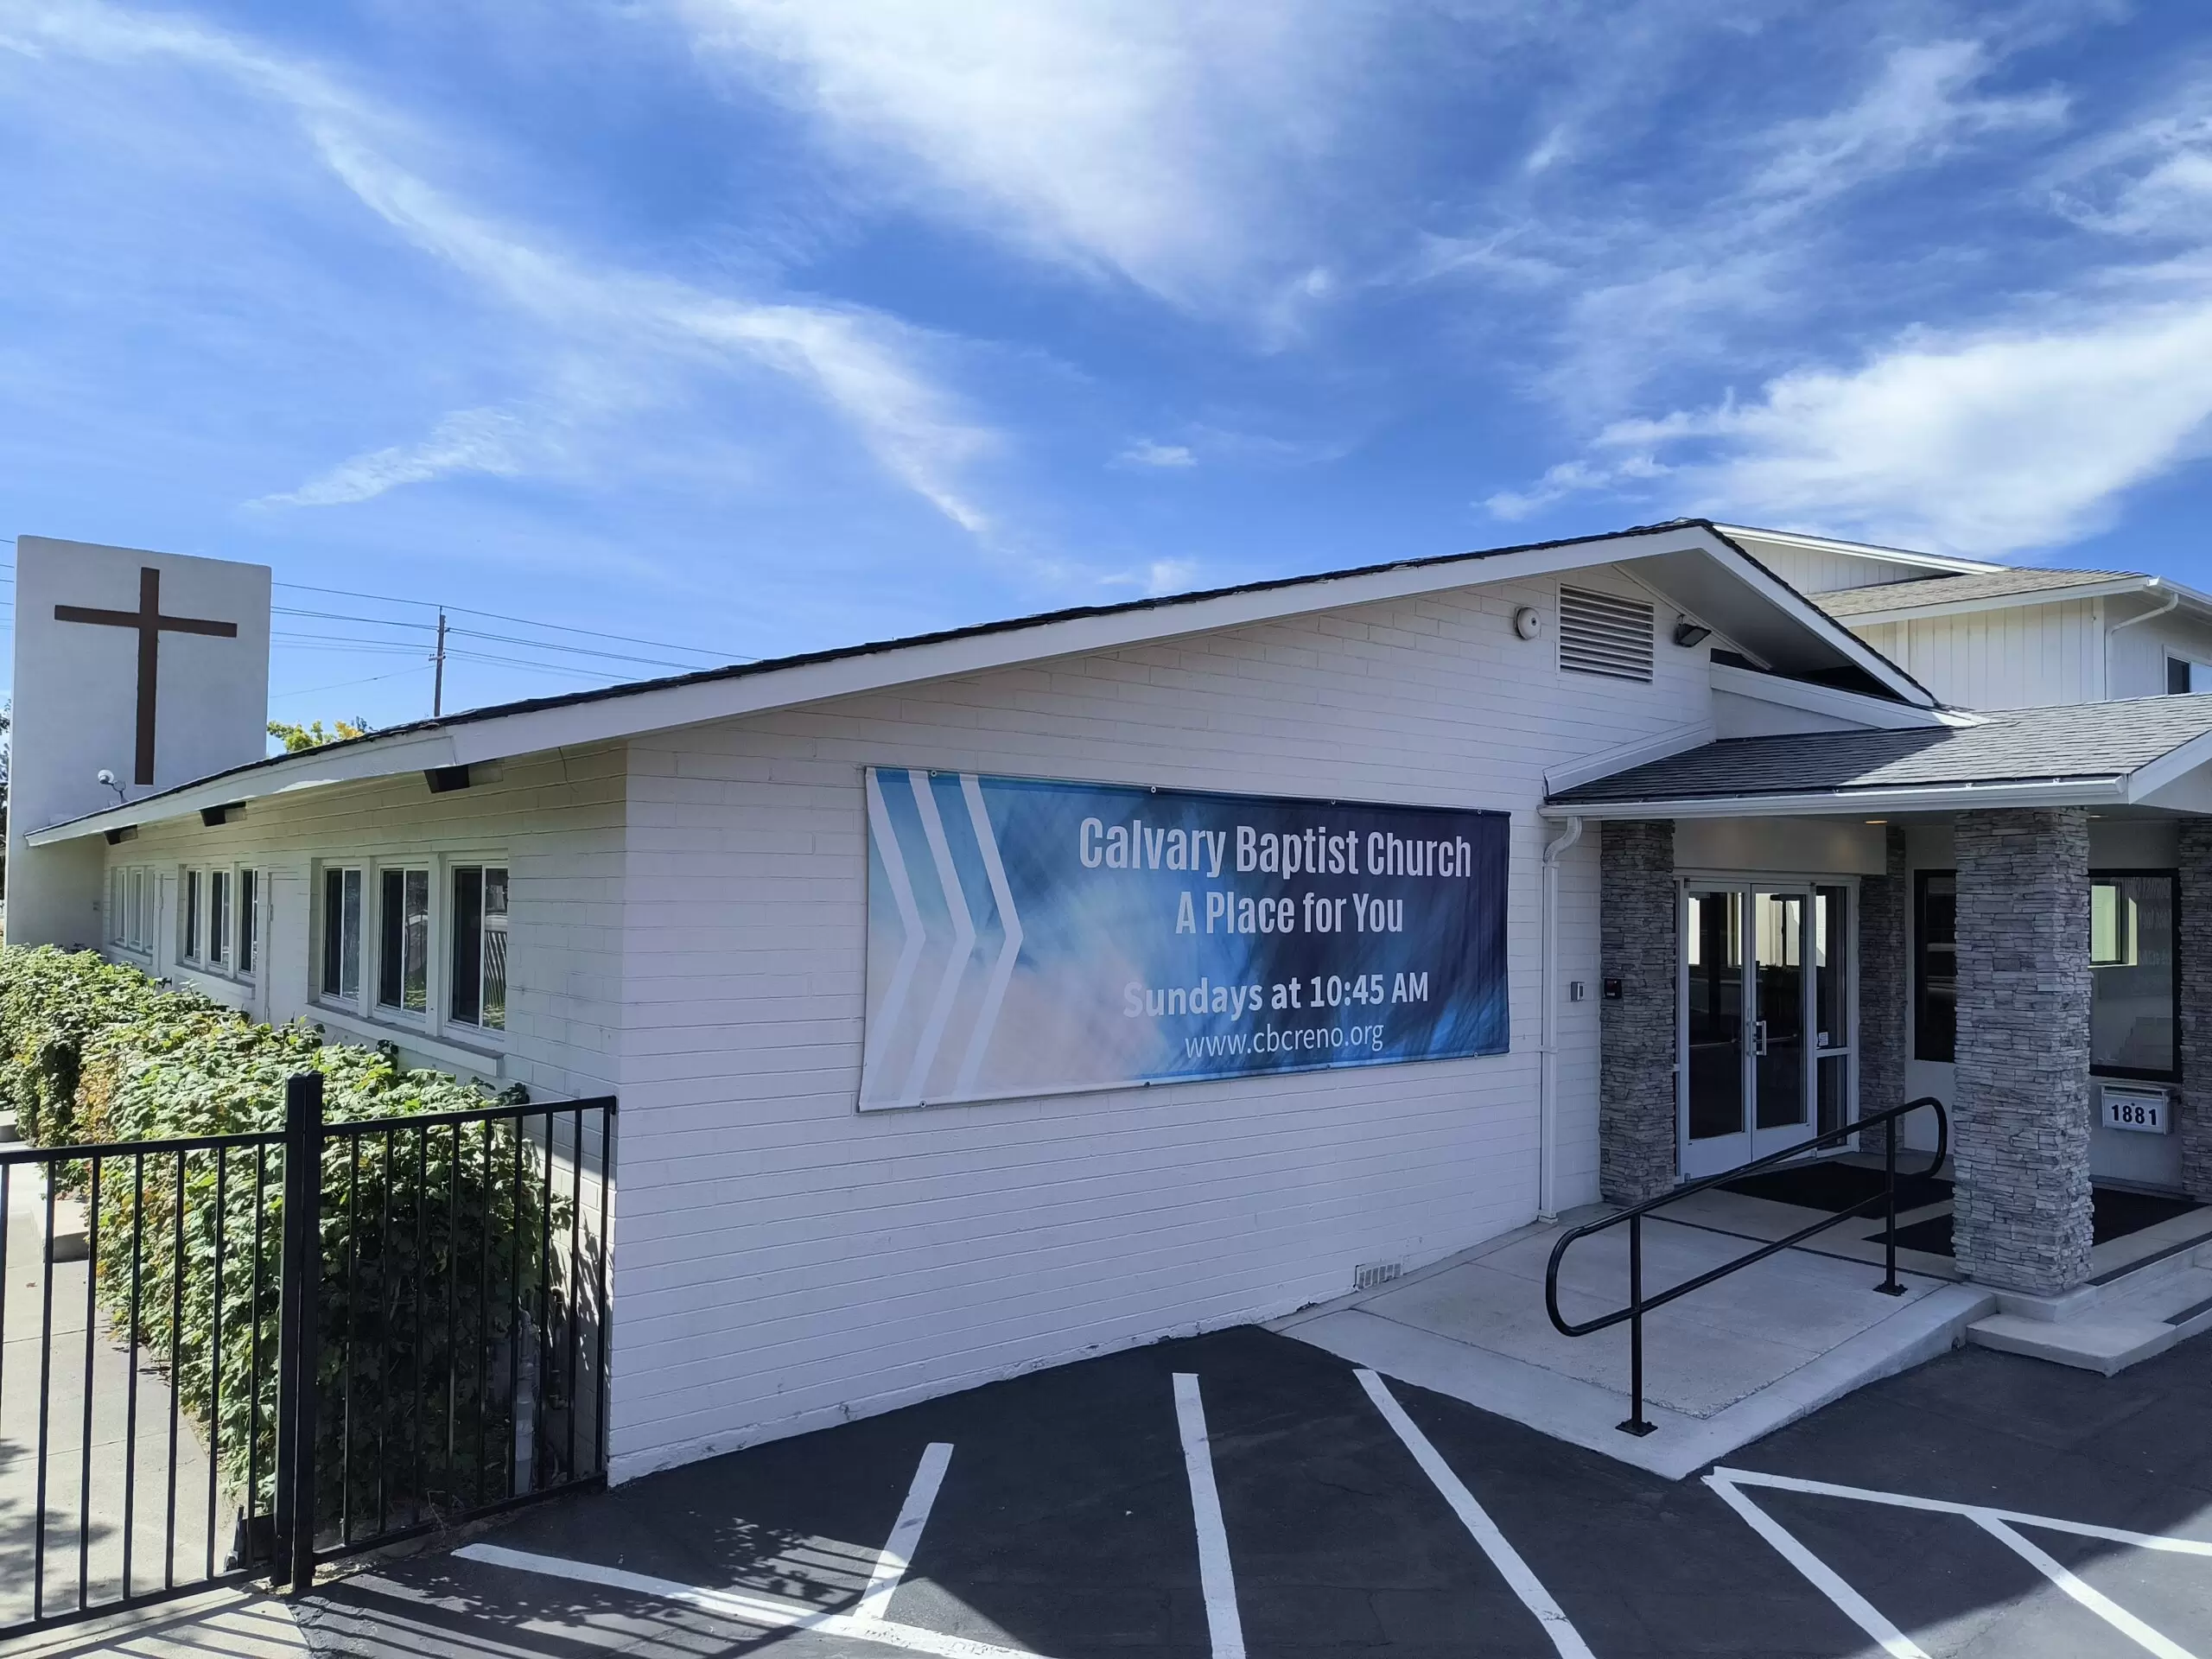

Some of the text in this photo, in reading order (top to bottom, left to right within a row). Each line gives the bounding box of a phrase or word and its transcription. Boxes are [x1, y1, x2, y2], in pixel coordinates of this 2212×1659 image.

[1079, 817, 1472, 880] Calvary Baptist Church
[1174, 891, 1404, 935] A Place for You
[1122, 971, 1429, 1021] Sundays at 10:45 AM
[1185, 1023, 1385, 1059] www.cbcreno.org
[2111, 1104, 2158, 1126] 1881
